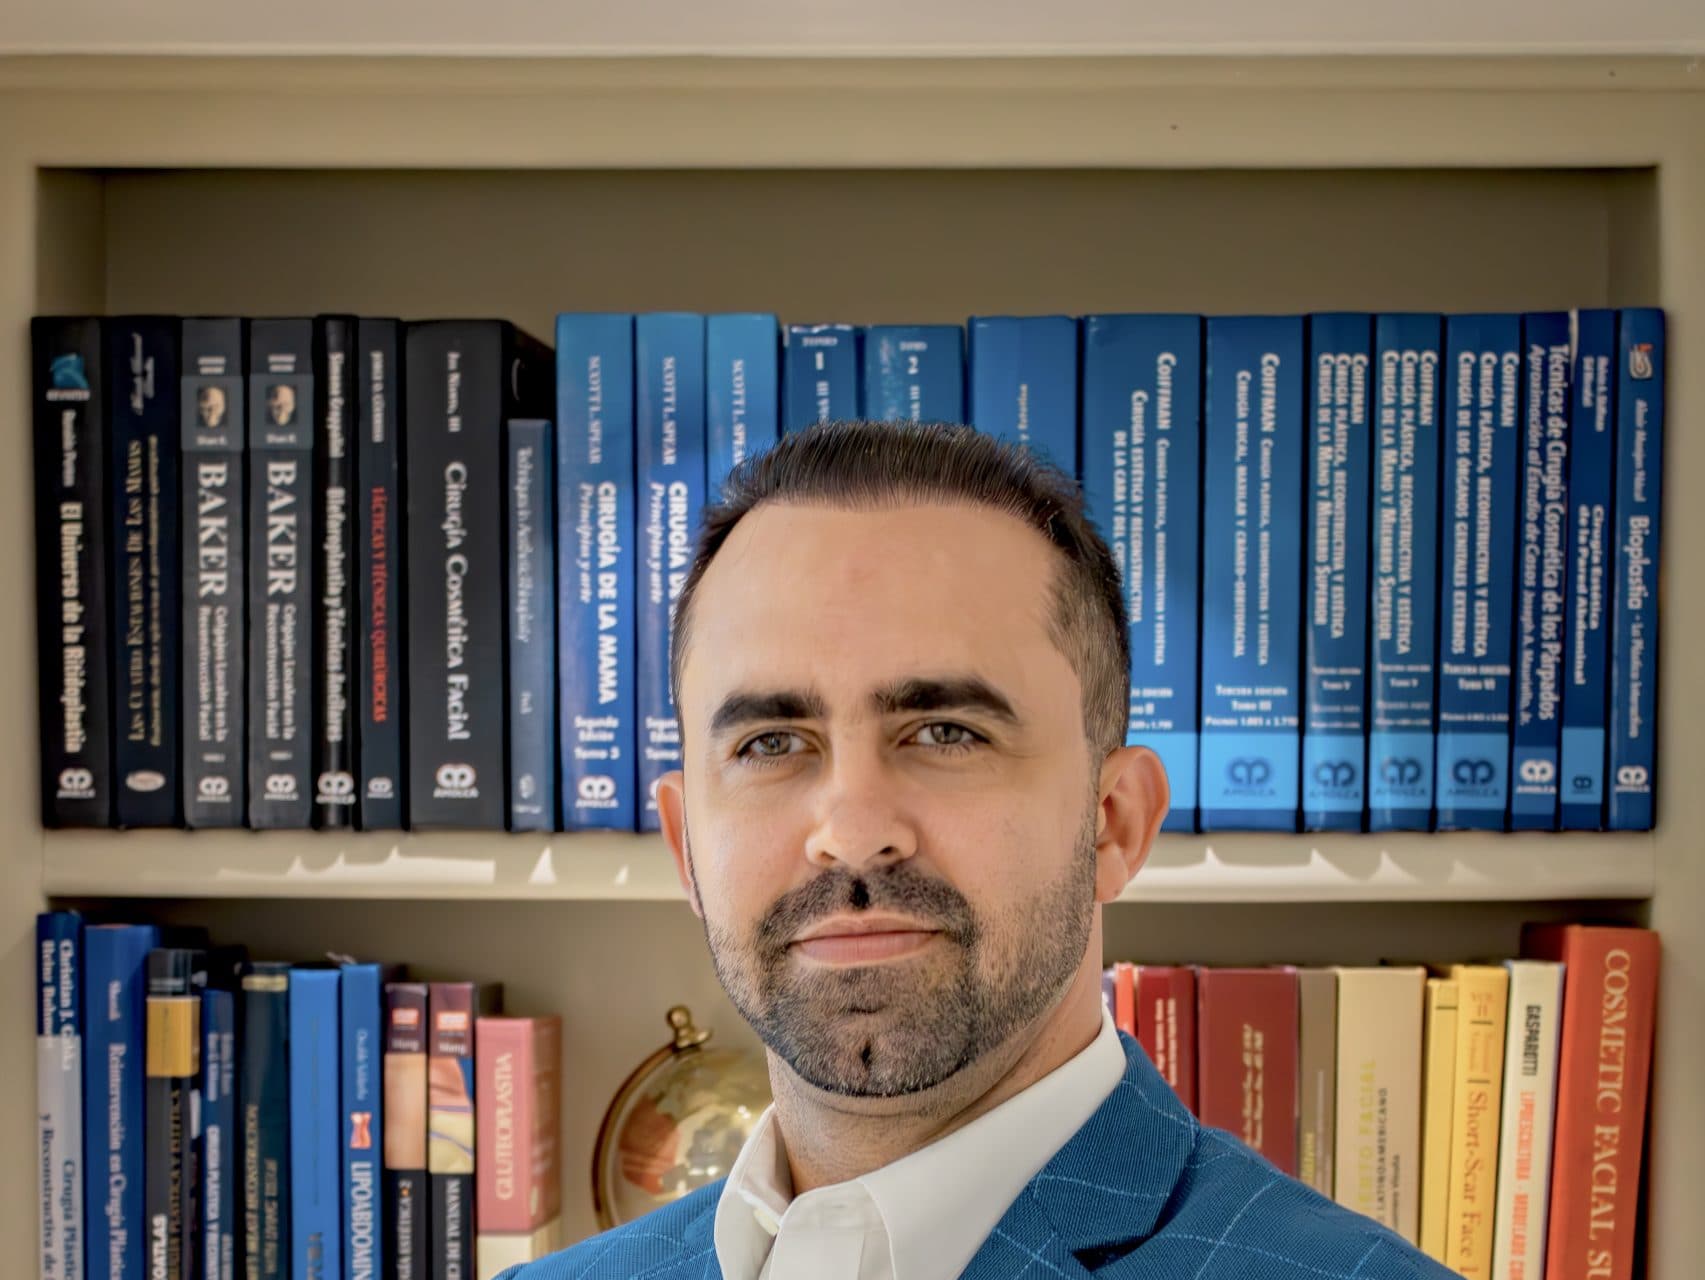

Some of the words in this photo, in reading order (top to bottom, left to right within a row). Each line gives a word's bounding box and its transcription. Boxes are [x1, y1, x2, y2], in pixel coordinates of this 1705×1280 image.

[588, 356, 601, 402] SCOTT
[1235, 371, 1251, 419] CIRUGÍA
[1317, 353, 1334, 405] CIRUGÍA
[1334, 353, 1350, 406] CIRUGÍA
[1351, 353, 1369, 424] COIFFMAN
[1419, 351, 1438, 425] COIFFMAN
[1457, 352, 1476, 408] CIRUGÍA
[1527, 345, 1546, 449] Aproximación
[1547, 345, 1569, 414] Técnicas
[588, 405, 601, 419] L.
[1131, 390, 1149, 445] CIRUGÍA
[1318, 407, 1332, 423] DE
[1318, 426, 1330, 443] LA
[1333, 407, 1348, 467] PLÁSTICA,
[1457, 410, 1472, 427] DE
[1547, 416, 1567, 439] de
[588, 420, 602, 464] SPEAR
[1113, 431, 1127, 449] DE
[1113, 450, 1127, 467] LA
[1234, 421, 1248, 462] BUCAL,
[1456, 429, 1471, 455] LOS
[1527, 449, 1543, 466] al
[1113, 468, 1127, 503] CARA
[1131, 447, 1145, 503] ESTÉTICA
[1235, 465, 1247, 516] MAXILAR
[1317, 445, 1332, 487] MANO
[1455, 456, 1473, 518] ÓRGANOS
[1542, 440, 1567, 501] Cirugía
[60, 502, 82, 520] El
[371, 487, 388, 549] TÁCTICAS
[441, 461, 467, 549] Cirugía
[1113, 504, 1127, 513] Y
[1131, 505, 1144, 514] Y
[1317, 489, 1330, 498] Y
[1525, 466, 1542, 521] Estudio
[1578, 504, 1590, 526] de
[197, 463, 228, 598] BAKER
[266, 461, 297, 596] BAKER
[323, 487, 346, 595] Blefaroplastia
[575, 483, 593, 557] Principios
[597, 482, 621, 568] CIRUGÍA
[645, 483, 665, 557] Principios
[667, 482, 691, 568] CIRUGÍA
[1112, 514, 1126, 539] DEL
[1235, 519, 1246, 527] Y
[1315, 501, 1332, 564] MIEMBRO
[1332, 470, 1346, 572] RECONSTRUCTIVA
[1525, 522, 1539, 543] de
[1542, 502, 1566, 589] Cosmética
[1577, 528, 1590, 544] la
[1589, 505, 1605, 565] Cirugía
[61, 522, 83, 598] Universo
[371, 550, 386, 560] Y
[575, 558, 589, 570] y
[645, 558, 660, 570] y
[1331, 574, 1344, 584] Y
[1453, 520, 1469, 588] GENITALES
[1524, 544, 1540, 587] Casos
[1576, 546, 1588, 595] Pared
[1622, 516, 1650, 609] Bioplastia
[322, 596, 342, 608] y
[371, 563, 388, 629] TÉCNICAS
[445, 554, 469, 669] Cosmética
[579, 571, 591, 603] arte
[598, 572, 617, 600] DE
[650, 571, 662, 603] arte
[1314, 565, 1331, 626] SUPERIOR
[1541, 590, 1563, 614] de
[1589, 566, 1603, 630] Estética
[62, 601, 85, 623] de
[62, 625, 85, 643] la
[212, 605, 229, 659] Colgajos
[598, 603, 617, 631] LA
[1330, 585, 1345, 639] ESTÉTICA
[1451, 589, 1467, 655] EXTERNOS
[1519, 590, 1536, 634] Joseph
[1540, 615, 1563, 641] los
[1631, 623, 1645, 638] La
[198, 605, 211, 700] Reconstrucción
[326, 608, 347, 671] Técnicas
[1573, 596, 1588, 685] Abdominal
[214, 661, 228, 708] Locales
[369, 630, 388, 722] QUIRÚRGICAS
[597, 634, 617, 705] MAMA
[1535, 642, 1562, 721] Párpados
[60, 645, 86, 753] Ritidoplastia
[198, 703, 211, 741] Facial
[214, 711, 226, 727] en
[447, 673, 471, 741] Facial
[574, 715, 618, 729] Segunda
[214, 729, 228, 742] la
[574, 747, 605, 760] Tomo
[578, 730, 615, 743] Edición
[59, 939, 75, 1009] Christian
[59, 1010, 75, 1022] J.
[1521, 1004, 1542, 1077] GASPAROTTI
[1596, 948, 1631, 1113] COSMETIC
[39, 1113, 54, 1124] y
[108, 1043, 127, 1150] Reintervención
[206, 1125, 220, 1170] CIRUGÍA
[495, 1053, 514, 1200] GLUTEOPLASTIA
[1376, 1088, 1388, 1210] LATINOAMERICANO
[1464, 1090, 1488, 1201] Short-Scar
[42, 1127, 56, 1251] Reconstructiva
[108, 1154, 123, 1173] en
[1588, 1124, 1621, 1241] FACIAL
[60, 1159, 78, 1222] Cirugía
[105, 1174, 127, 1228] Cirugía
[205, 1171, 221, 1221] PLÁSTICA
[446, 1180, 461, 1240] MANUAL
[205, 1222, 219, 1231] Y
[446, 1241, 461, 1259] DE
[1459, 1211, 1480, 1258] Face
[1509, 1194, 1529, 1256] MODELADO
[43, 1253, 56, 1274] de
